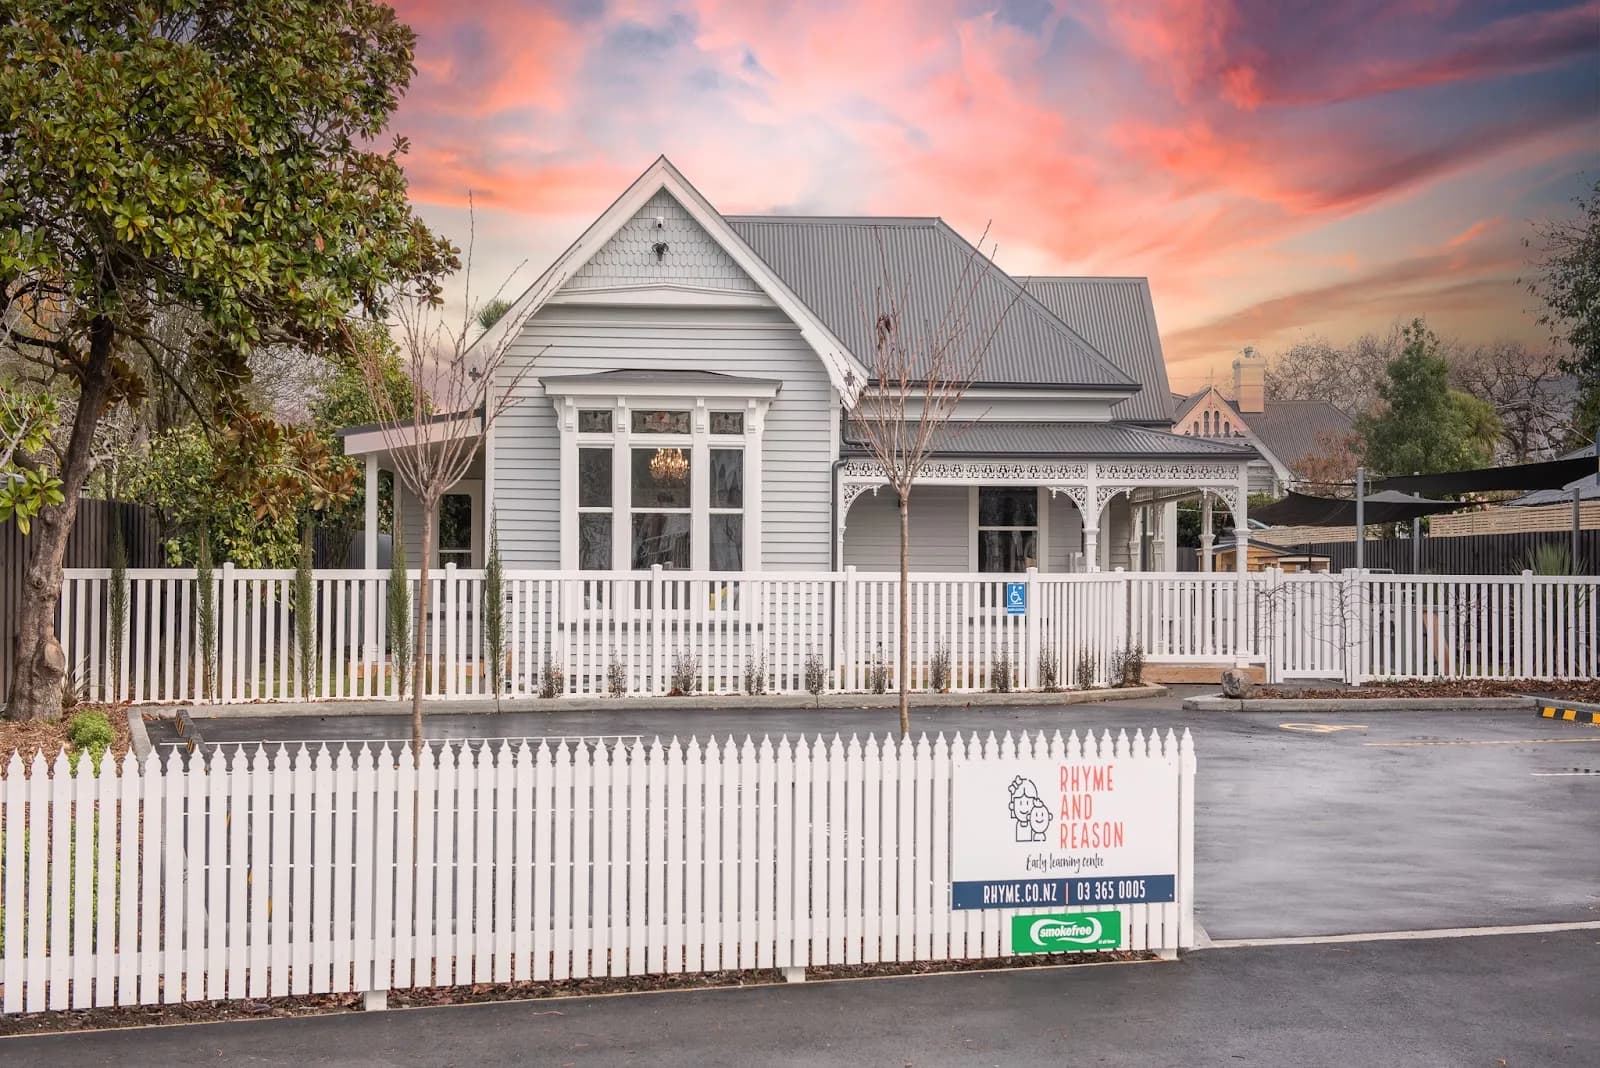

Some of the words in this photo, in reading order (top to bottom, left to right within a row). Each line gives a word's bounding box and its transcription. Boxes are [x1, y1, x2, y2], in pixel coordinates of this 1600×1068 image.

[1060, 765, 1114, 792] RHYME
[1060, 794, 1093, 820] AND
[1060, 821, 1124, 849] REASON
[1026, 853, 1047, 873] Early
[1049, 852, 1080, 874] learning
[1082, 852, 1104, 869] centre
[983, 883, 1057, 904] RHYME.CO.NZ
[1077, 881, 1090, 900] 03
[1095, 881, 1114, 899] 365
[1118, 880, 1146, 898] 0005
[1039, 924, 1092, 938] smokefree
